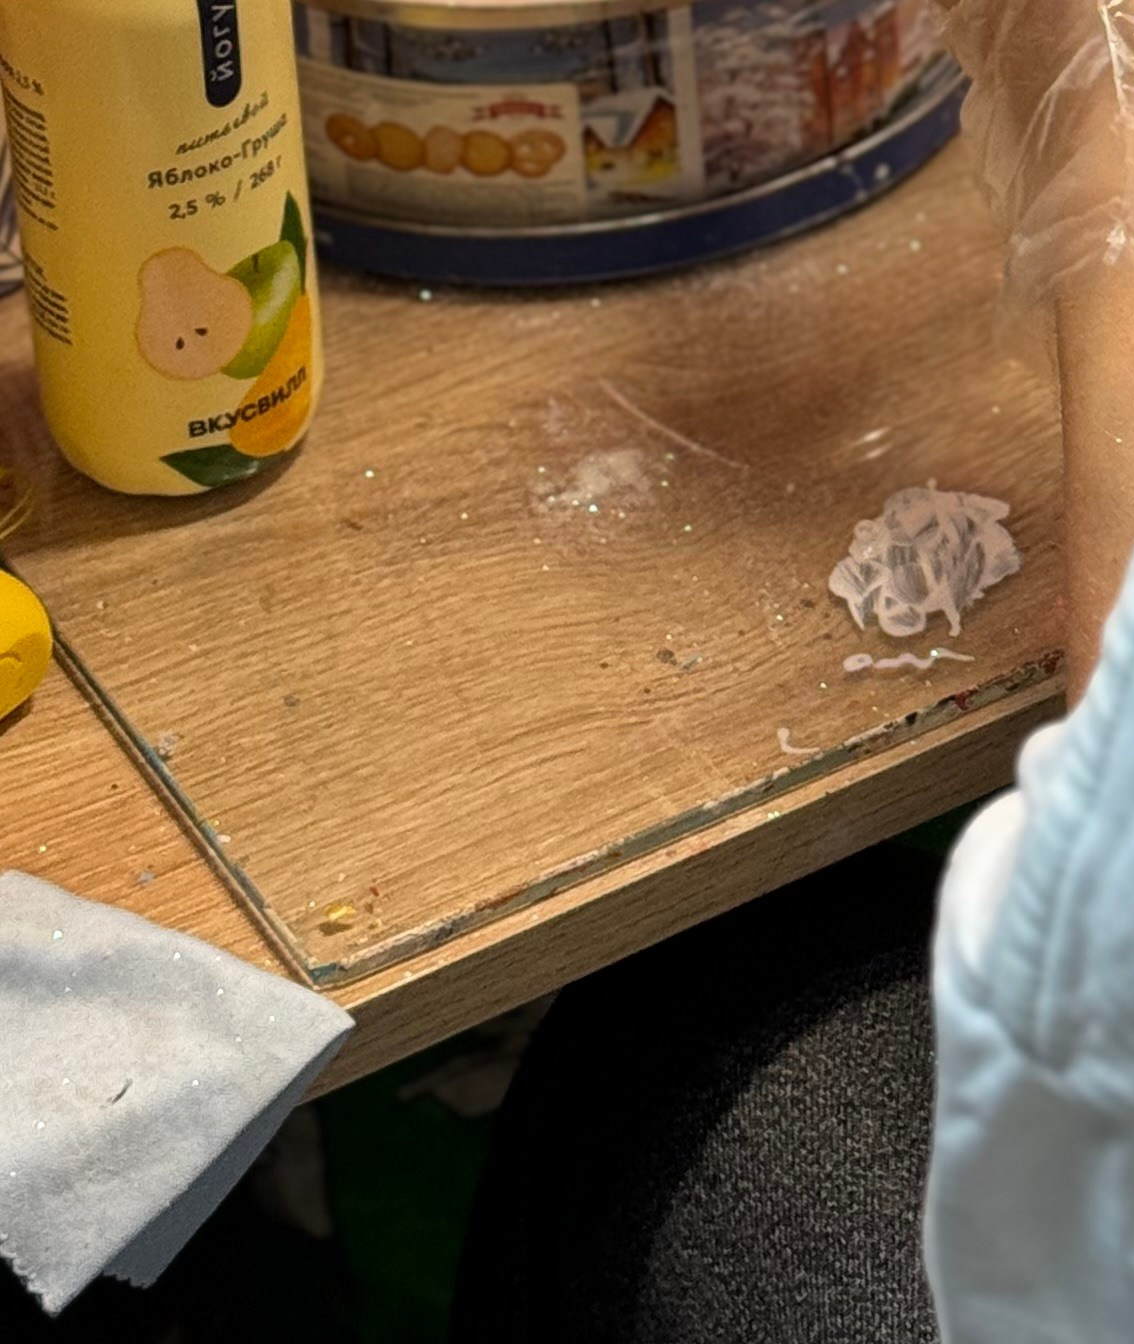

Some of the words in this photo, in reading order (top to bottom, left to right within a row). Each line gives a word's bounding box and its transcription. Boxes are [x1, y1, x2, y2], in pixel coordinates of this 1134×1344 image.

[148, 113, 287, 189] Яблоко-Груша
[175, 90, 270, 155] питьевой
[168, 199, 199, 220] 2,5
[205, 191, 226, 209] %
[187, 365, 306, 438] ВКУСВИЛЛ
